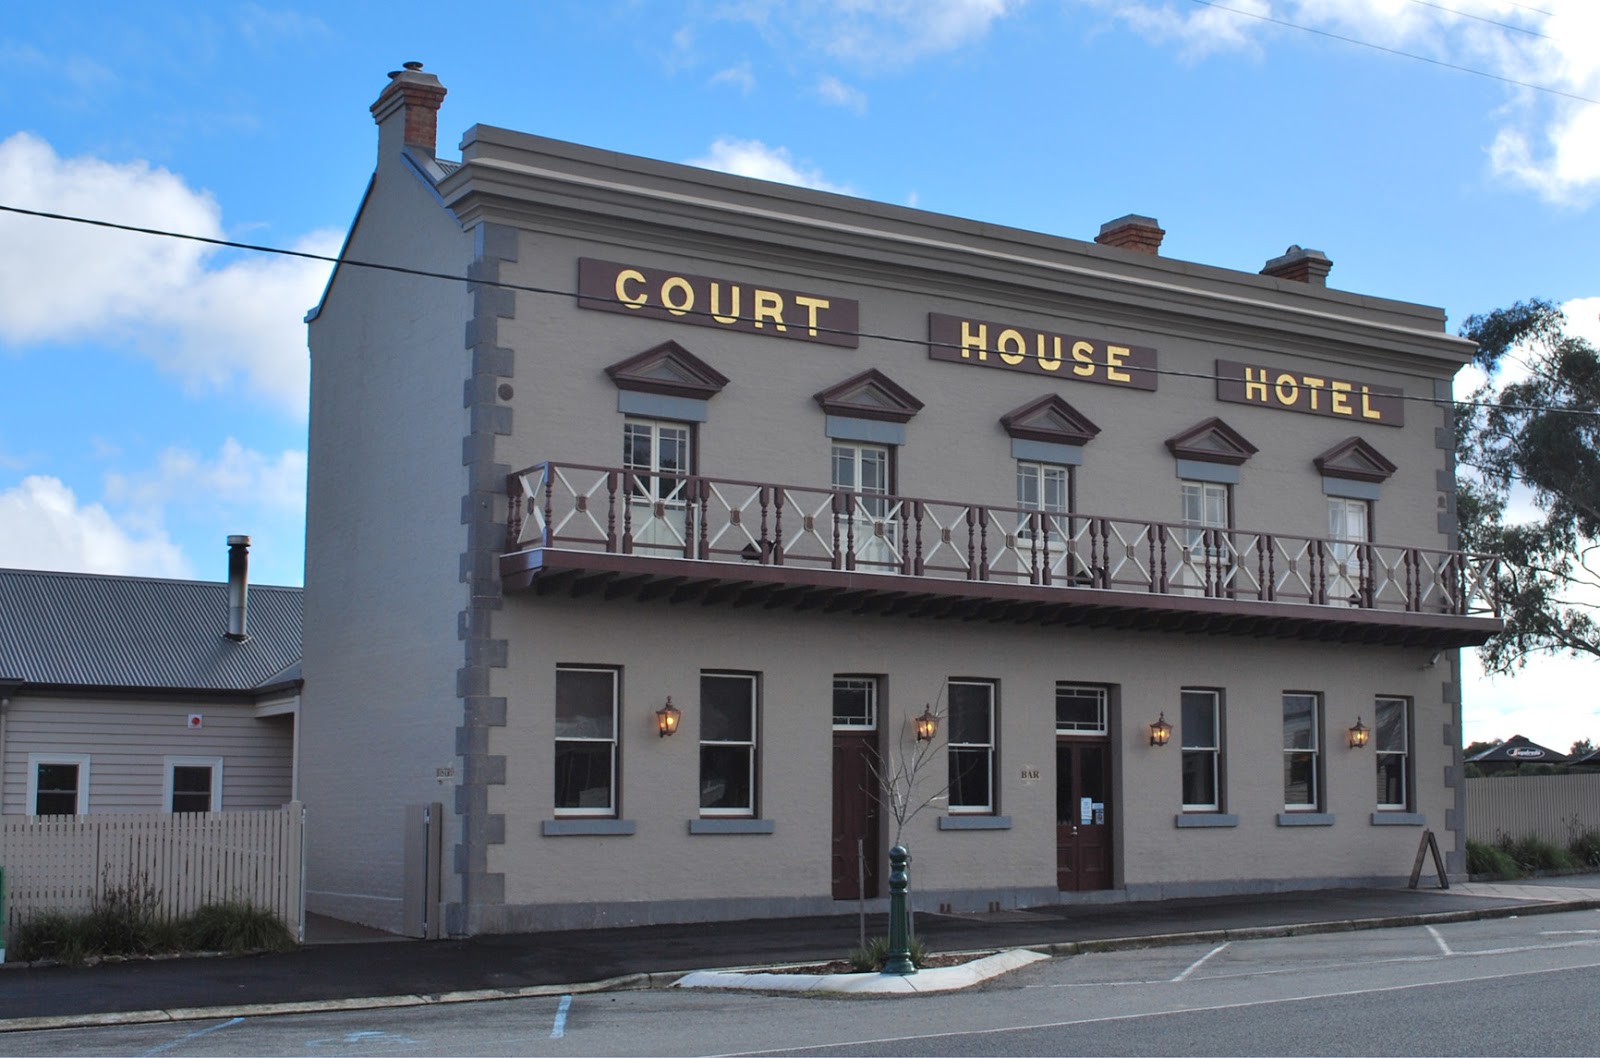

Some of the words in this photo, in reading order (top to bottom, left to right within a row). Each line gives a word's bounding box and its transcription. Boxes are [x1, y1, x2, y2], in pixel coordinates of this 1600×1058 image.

[614, 269, 830, 337] COURT
[961, 321, 1131, 383] HOUSE
[1245, 367, 1381, 419] HOTEL
[1021, 770, 1040, 779] BAR
